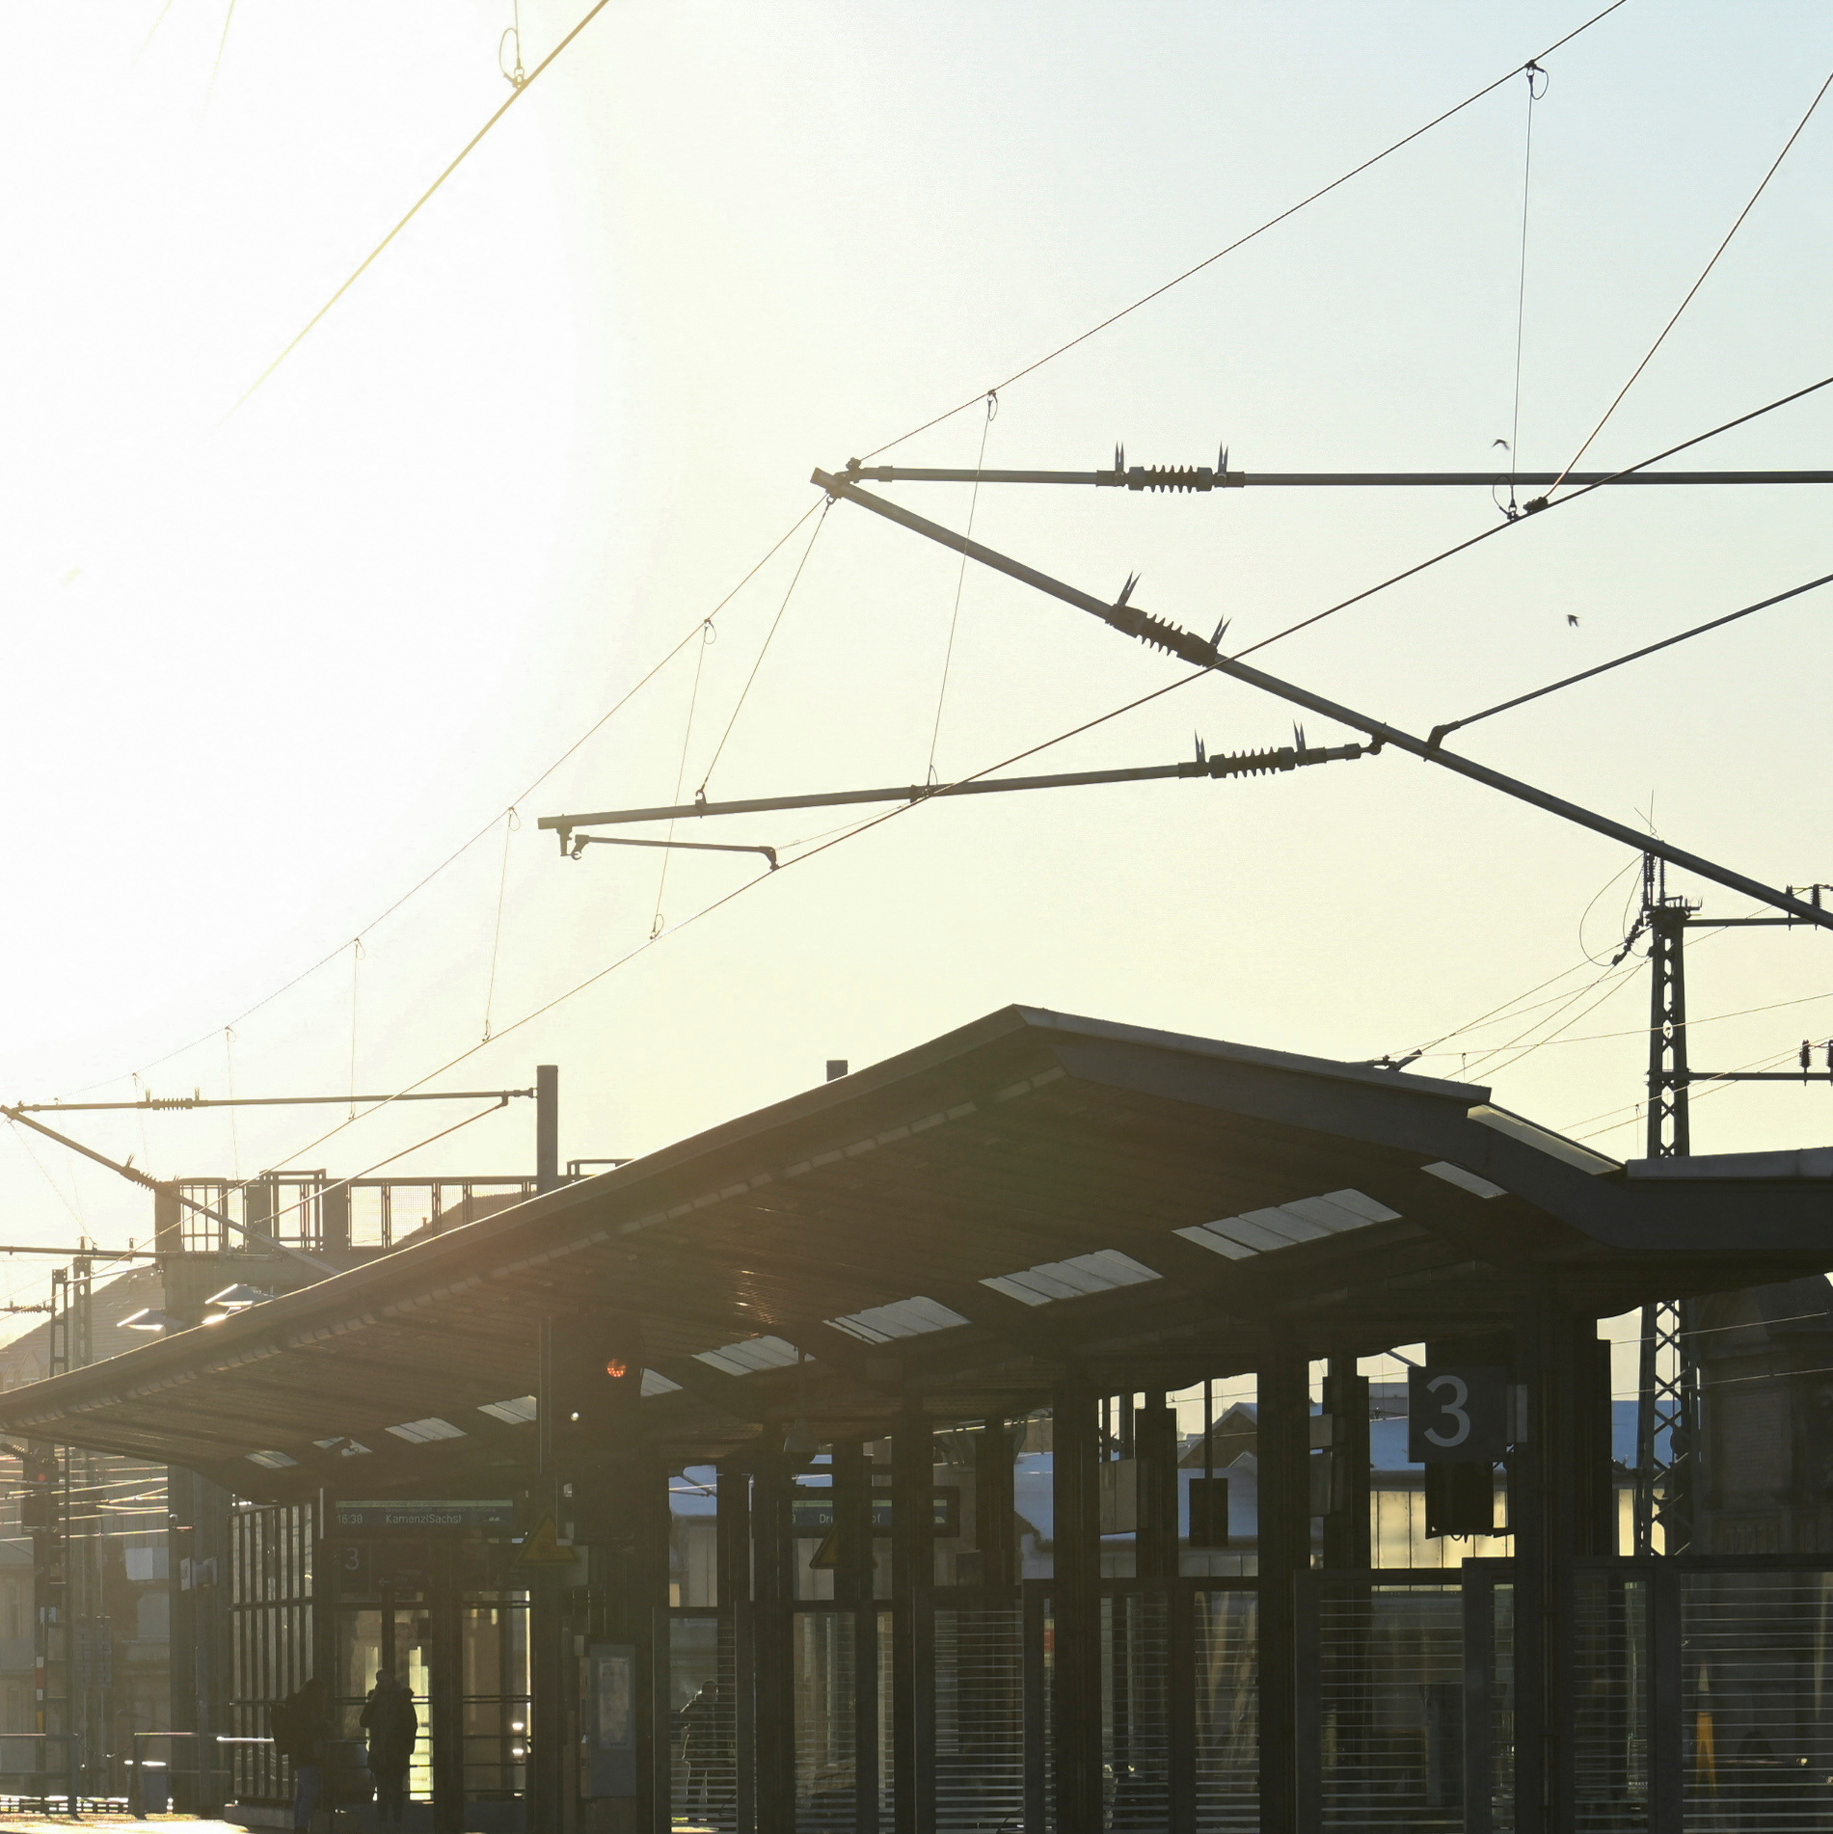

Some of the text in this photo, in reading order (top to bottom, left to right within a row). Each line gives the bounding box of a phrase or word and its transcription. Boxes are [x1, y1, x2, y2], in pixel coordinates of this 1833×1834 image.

[1423, 1374, 1471, 1448] 3
[337, 1514, 363, 1525] 16:38
[344, 1546, 360, 1571] 3
